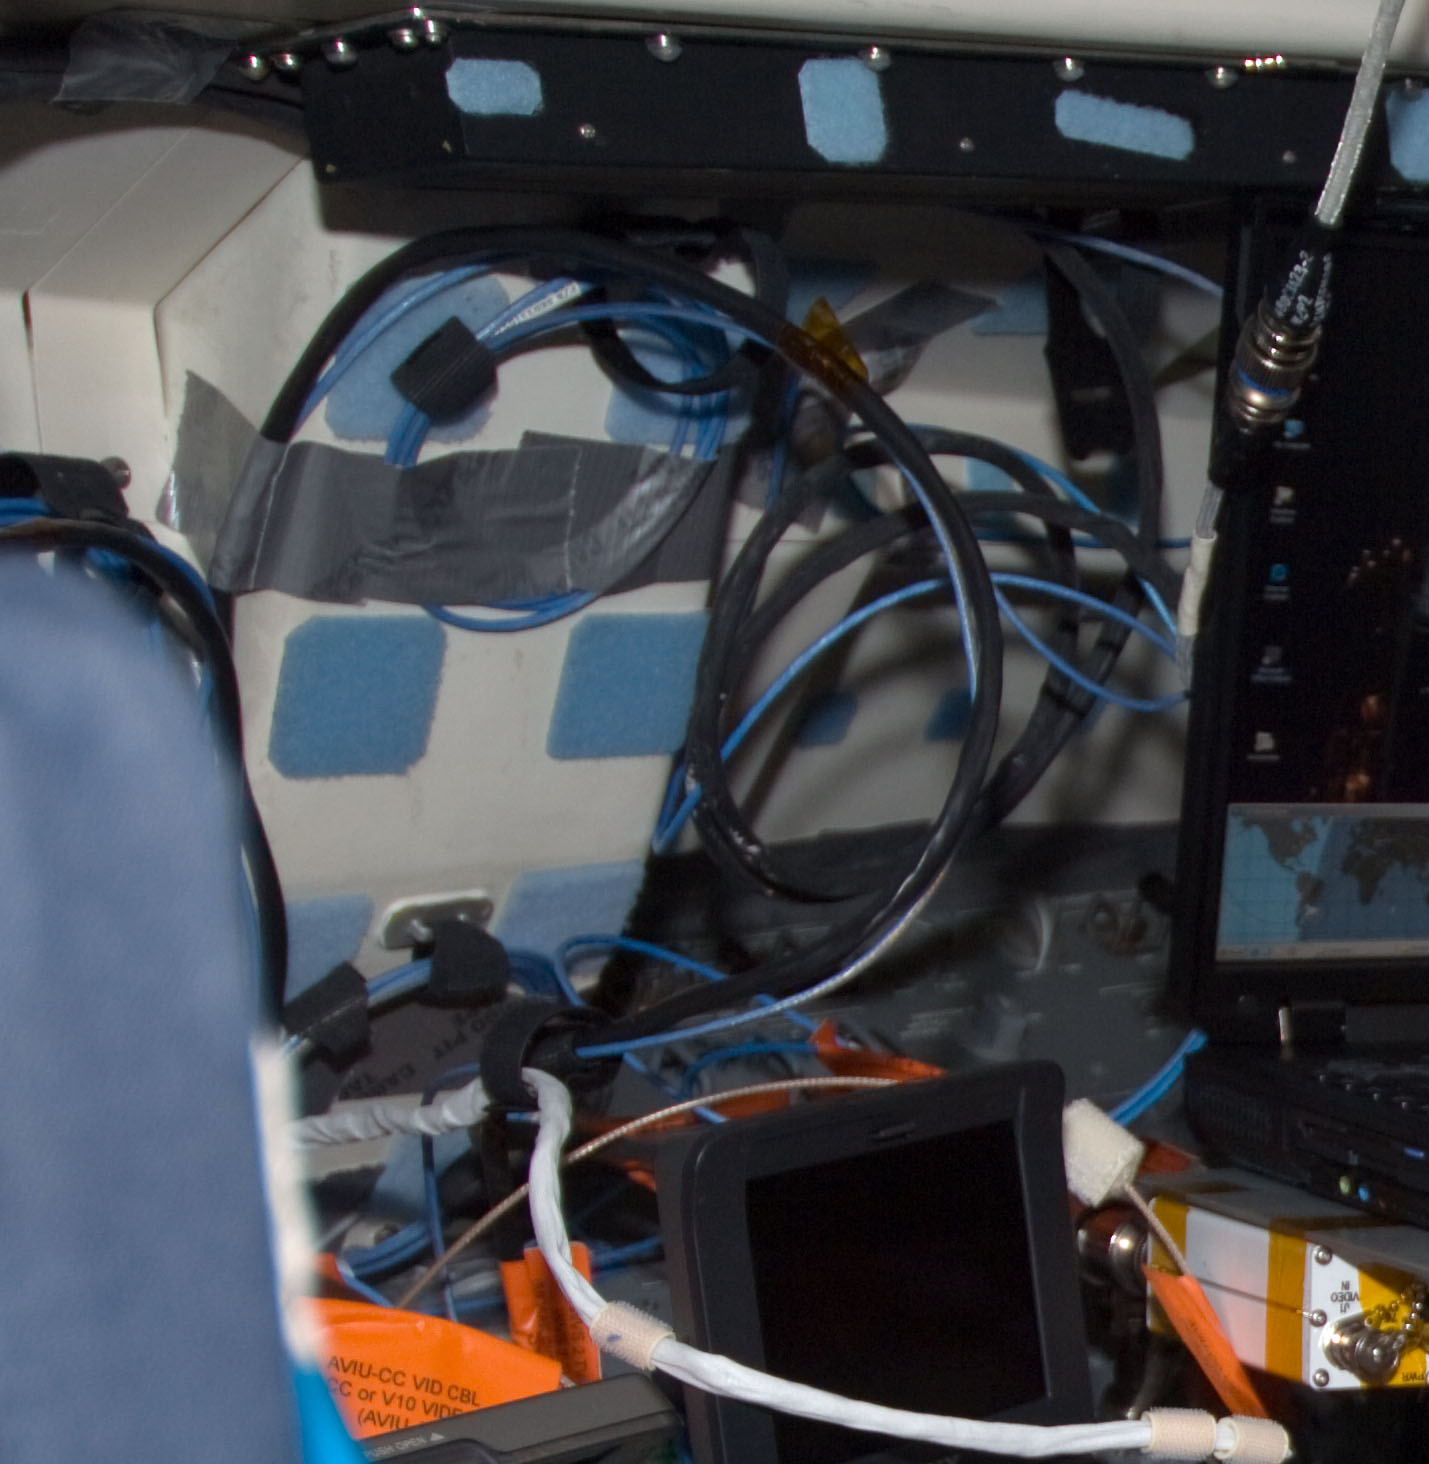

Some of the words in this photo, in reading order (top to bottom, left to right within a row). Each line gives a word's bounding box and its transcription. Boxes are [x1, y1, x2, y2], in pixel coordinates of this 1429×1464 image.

[1340, 1280, 1351, 1291] IN
[1330, 1291, 1361, 1304] VIDEO
[327, 1355, 407, 1388] AVIU-CC
[412, 1373, 443, 1396] VID
[446, 1384, 481, 1408] CBL
[357, 1386, 377, 1402] or
[380, 1391, 417, 1412] V10
[396, 1436, 428, 1449] OPEN
